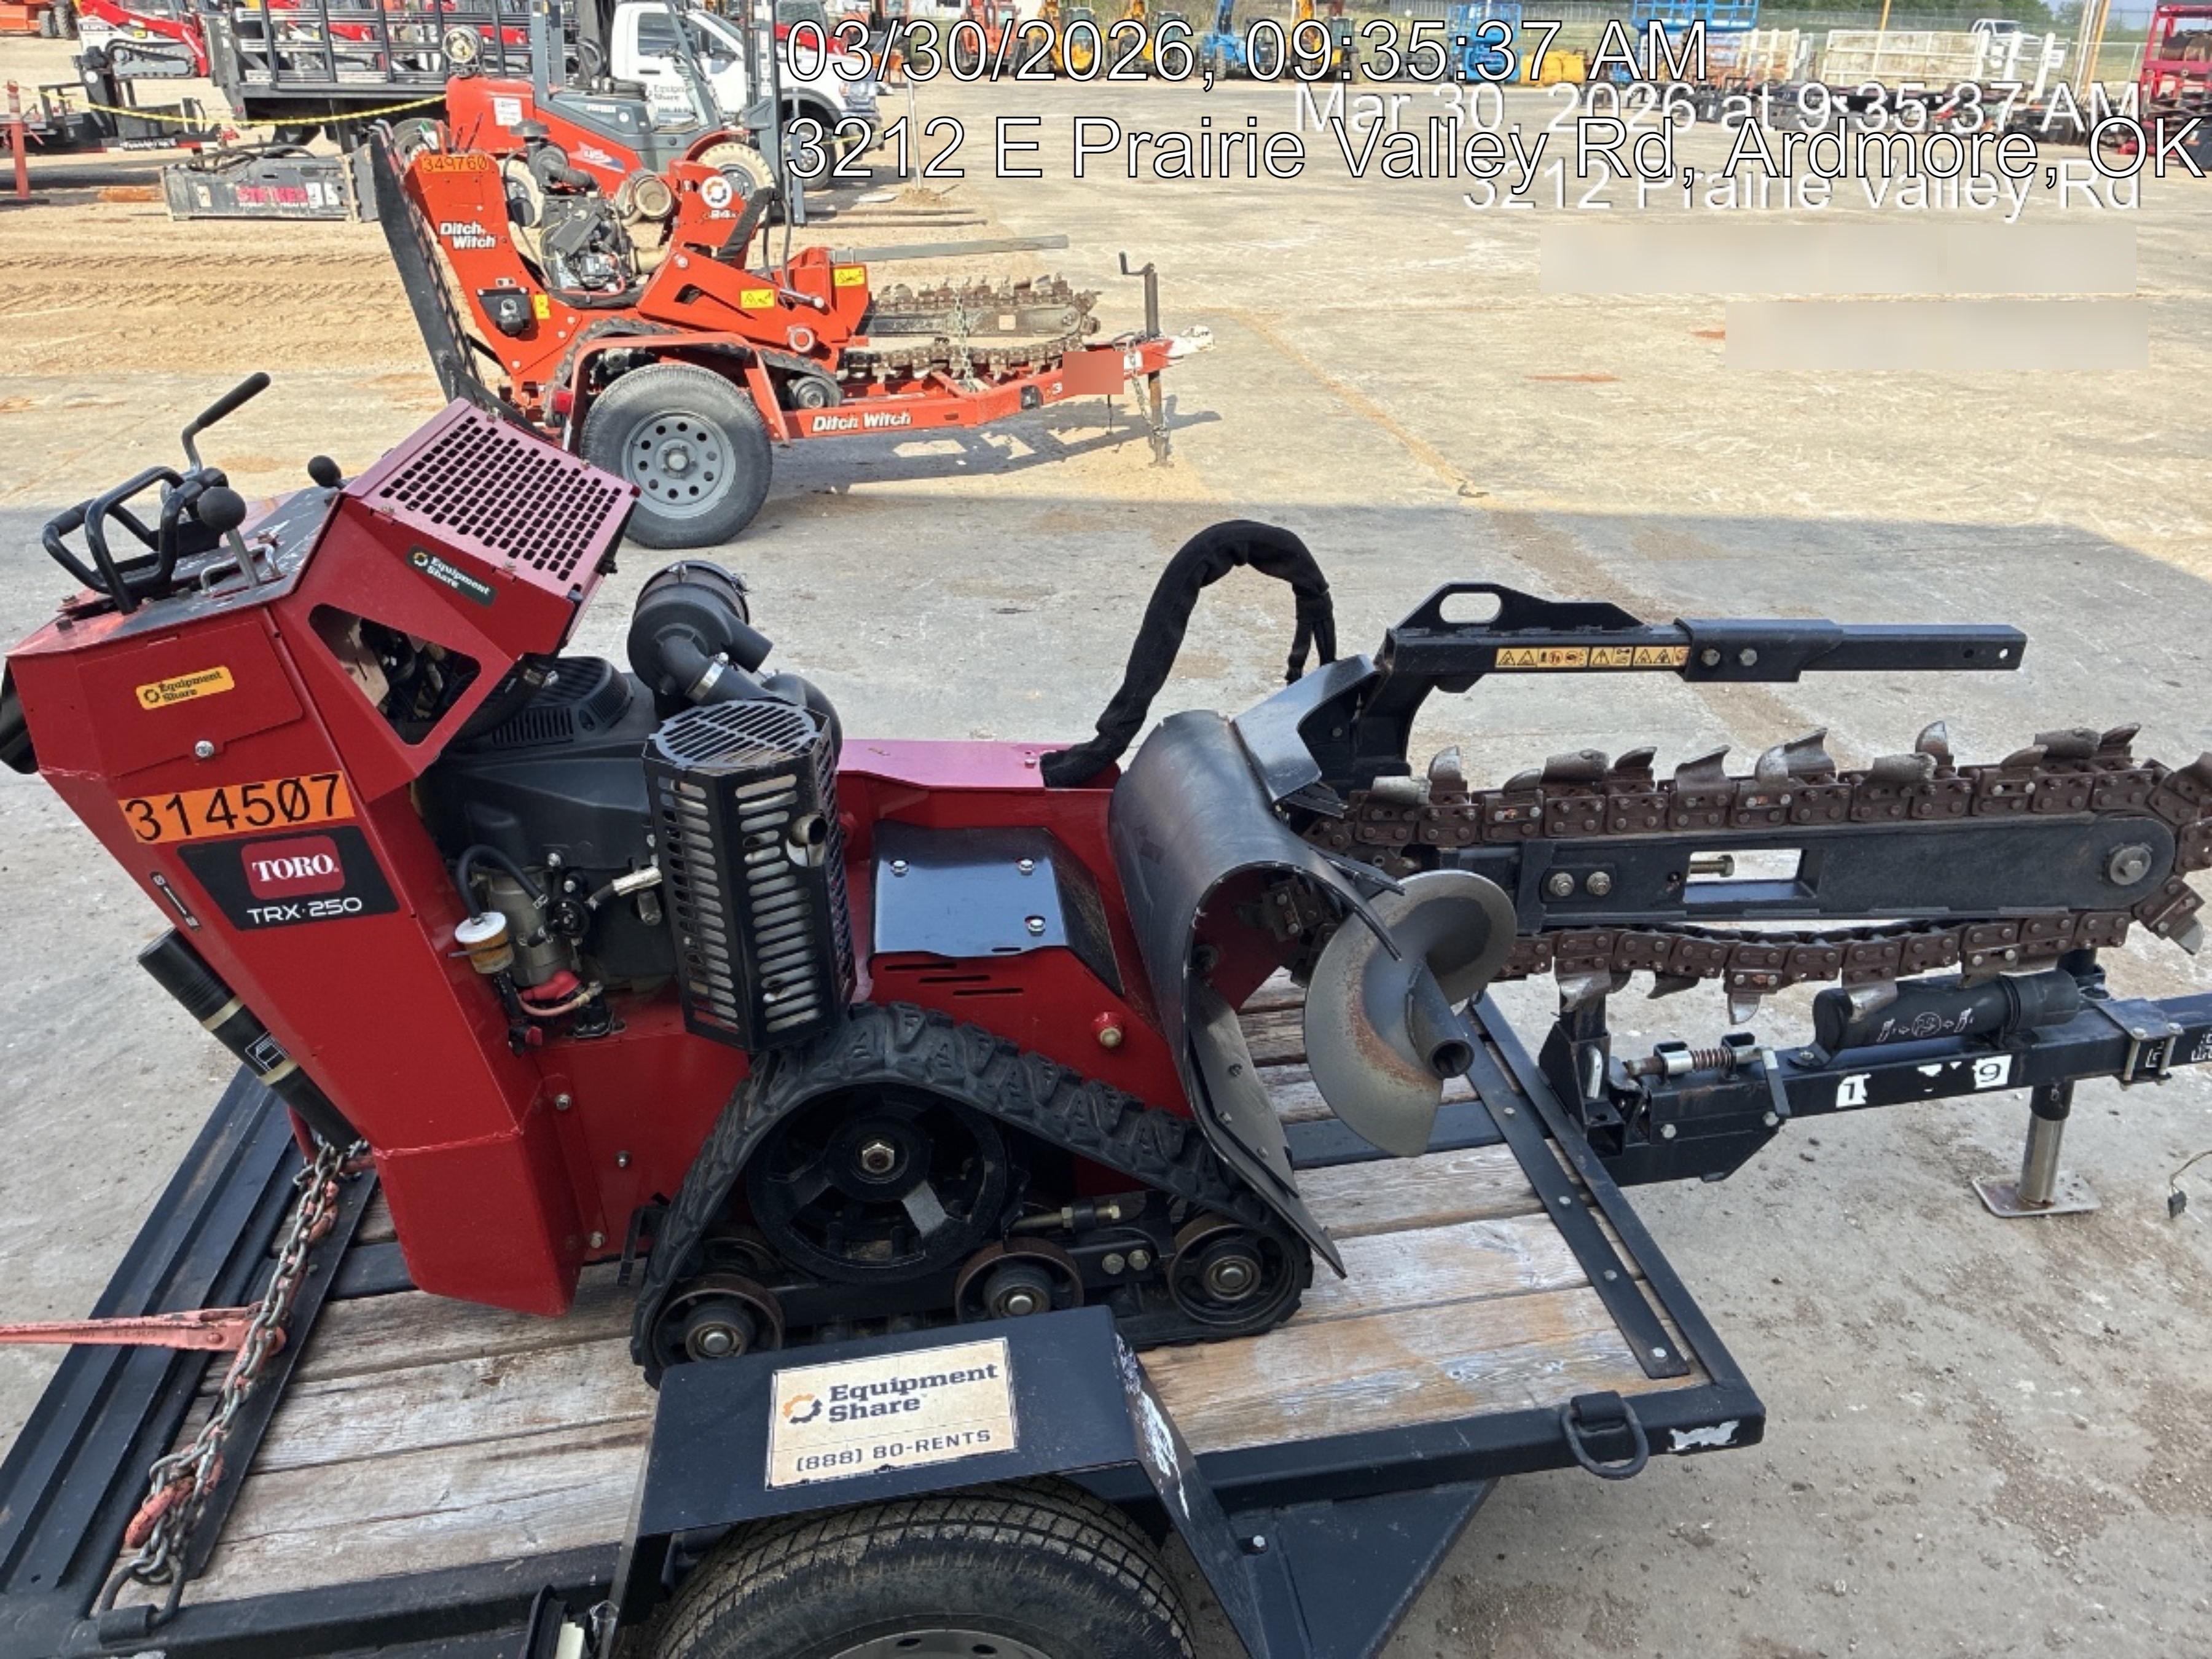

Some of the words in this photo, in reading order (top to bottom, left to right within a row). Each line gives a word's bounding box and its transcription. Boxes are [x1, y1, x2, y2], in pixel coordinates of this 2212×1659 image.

[423, 155, 488, 171] 349760
[440, 221, 482, 235] Ditch
[452, 235, 496, 249] Witch
[812, 415, 859, 432] Ditch
[863, 411, 912, 428] Witch
[427, 565, 460, 589] Share
[431, 555, 491, 596] Equipment
[158, 670, 222, 692] Equipment
[162, 689, 198, 702] Share
[124, 772, 340, 842] 314507
[251, 852, 335, 882] TORO
[828, 1363, 998, 1402] Equipment
[828, 1395, 921, 1423] Share
[796, 1448, 863, 1472] (888)
[873, 1429, 991, 1459] 80-RENTS
